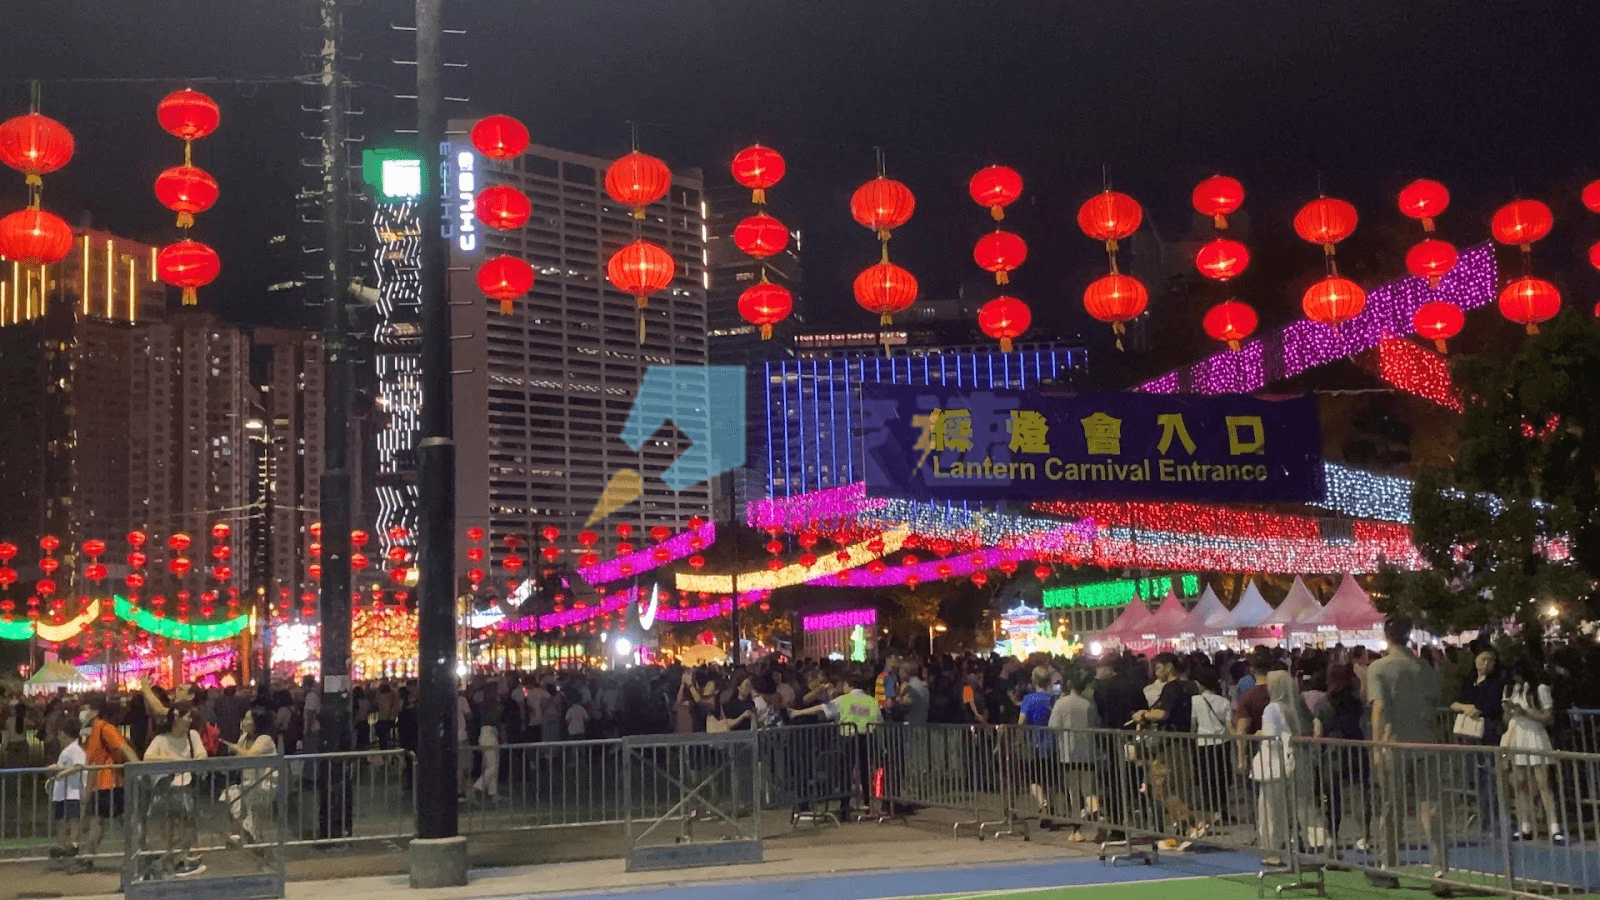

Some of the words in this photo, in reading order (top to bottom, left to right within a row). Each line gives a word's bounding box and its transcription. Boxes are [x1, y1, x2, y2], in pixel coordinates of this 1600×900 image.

[458, 152, 476, 251] CHUBB
[933, 456, 1036, 480] Lantern
[1044, 457, 1151, 482] Carnival
[1158, 459, 1268, 483] Entrance
